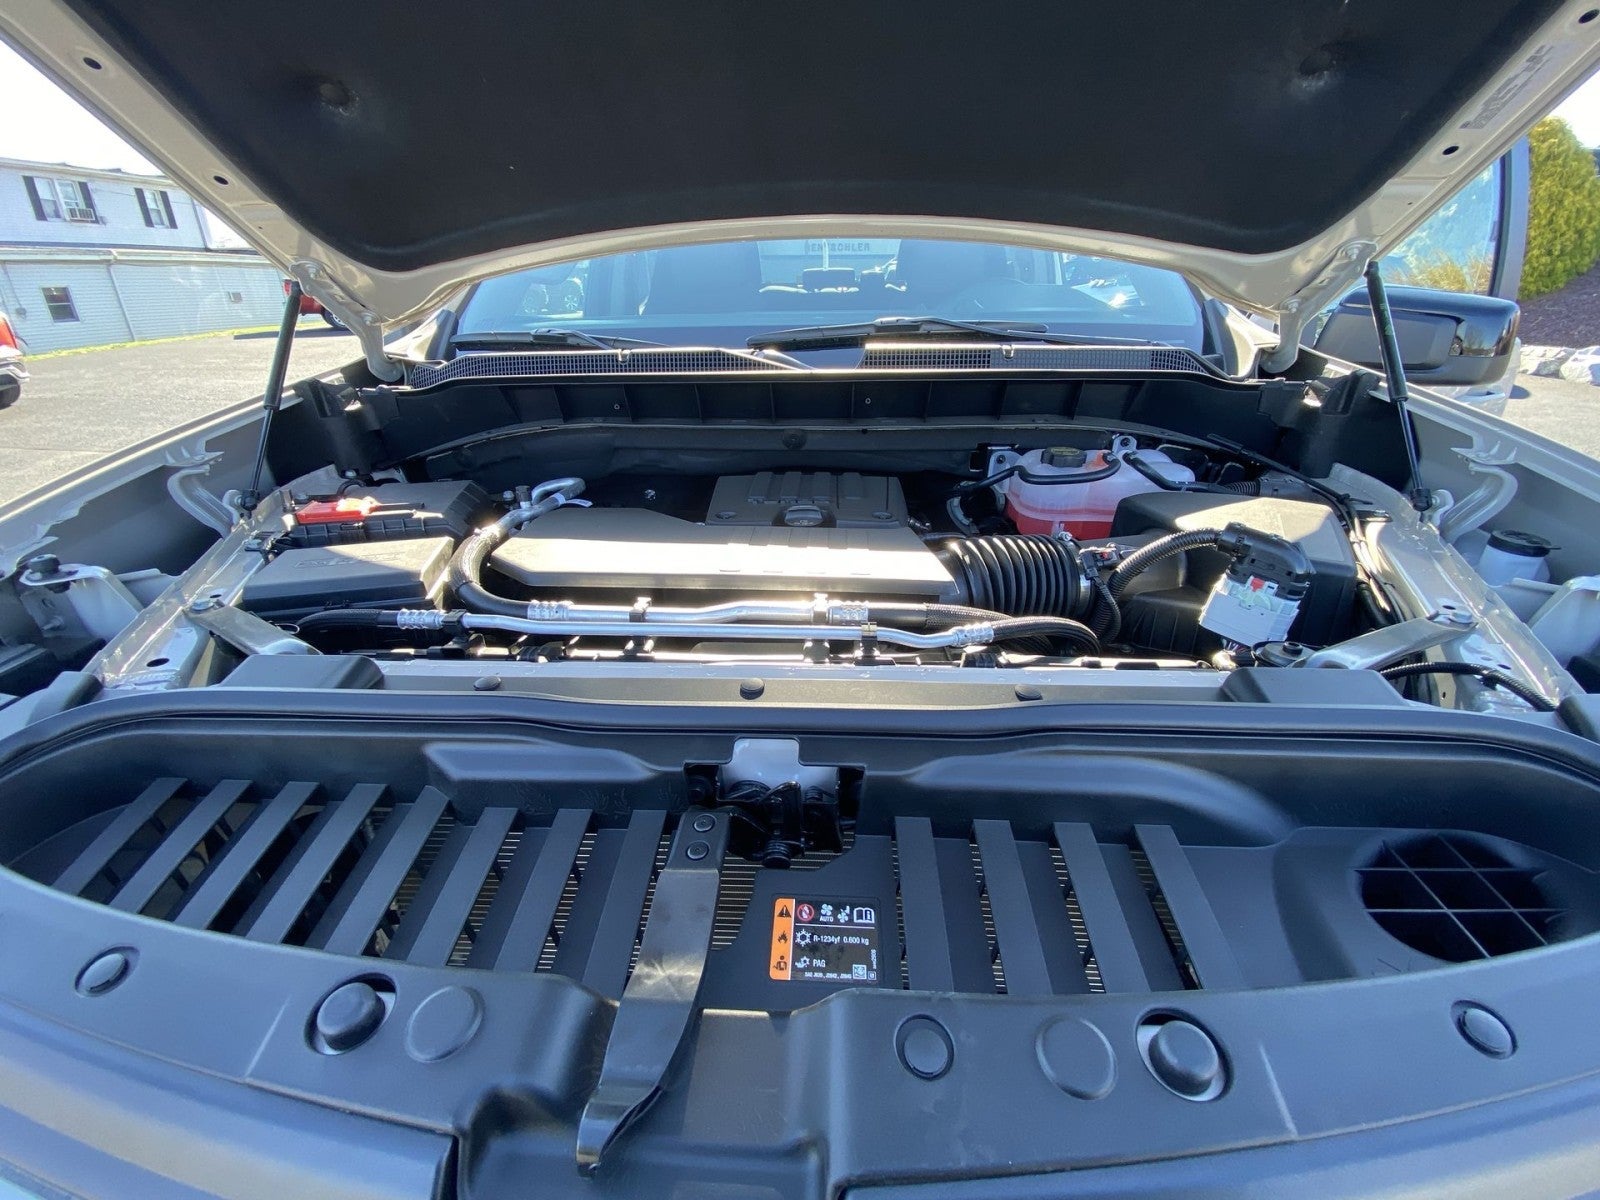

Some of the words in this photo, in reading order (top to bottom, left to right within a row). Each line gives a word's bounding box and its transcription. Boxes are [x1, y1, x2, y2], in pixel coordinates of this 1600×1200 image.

[813, 935, 840, 944] R-1234yf
[861, 937, 869, 945] kg
[813, 959, 825, 967] PAG
